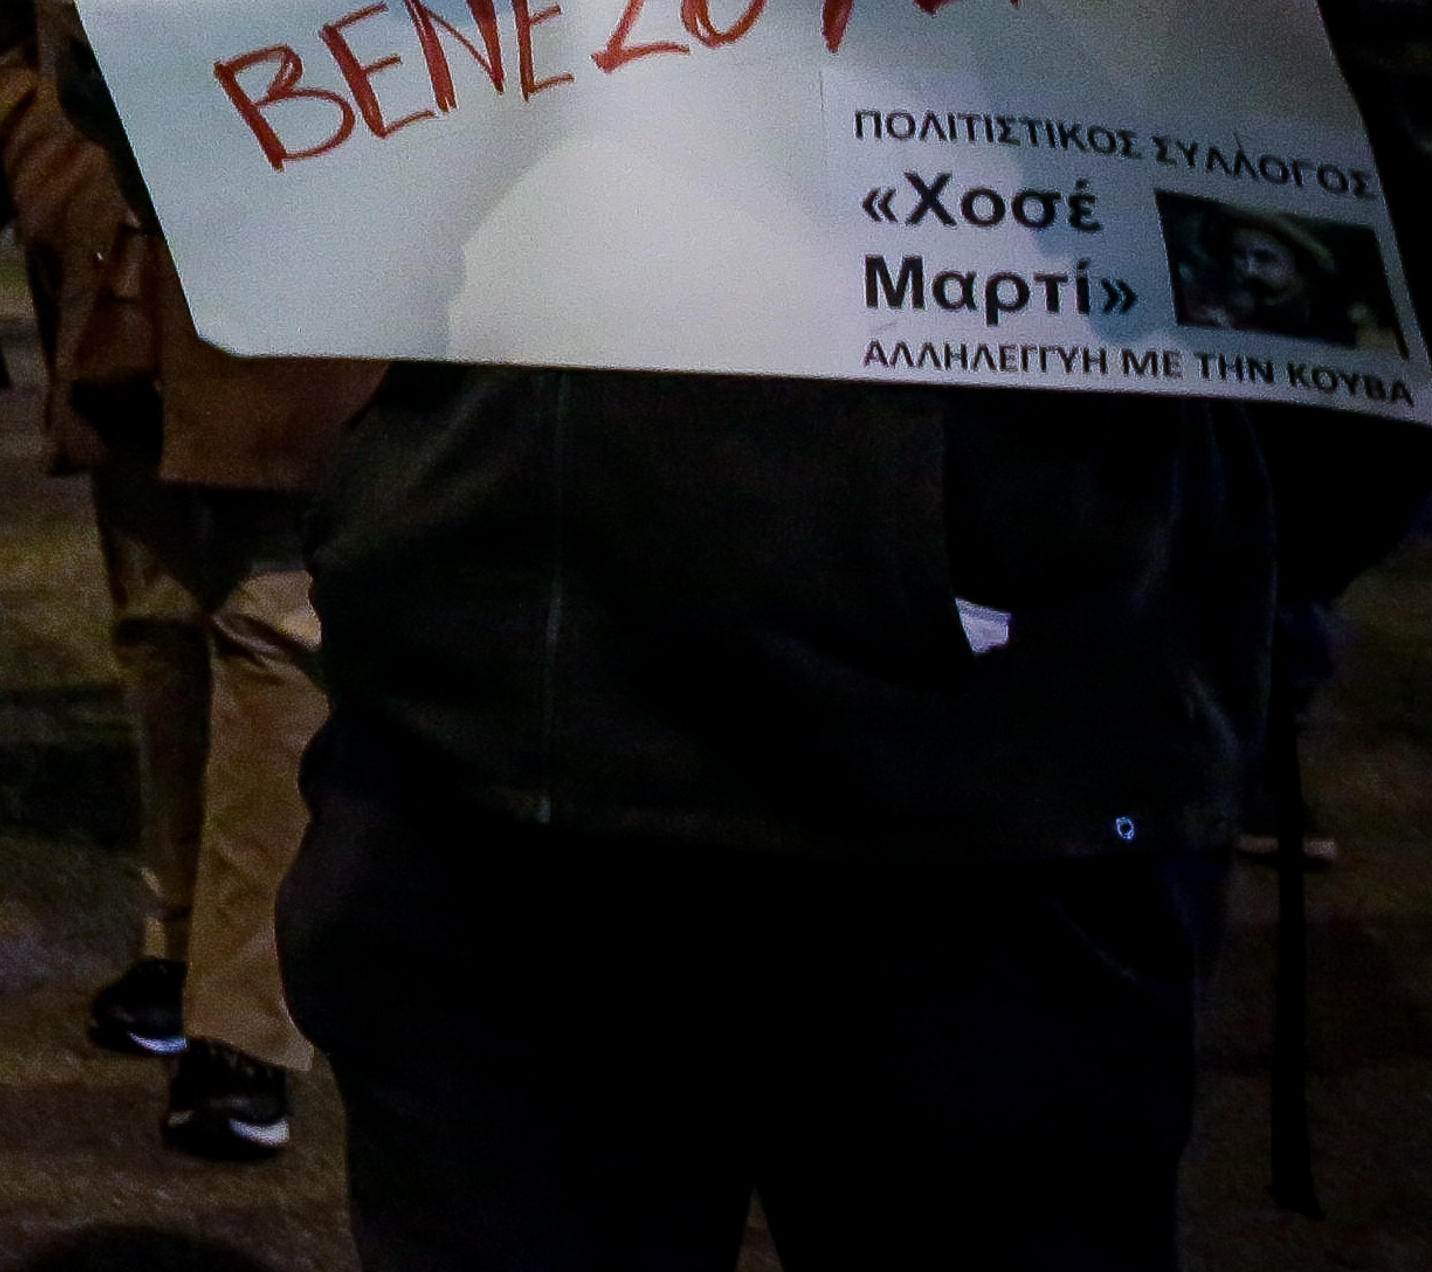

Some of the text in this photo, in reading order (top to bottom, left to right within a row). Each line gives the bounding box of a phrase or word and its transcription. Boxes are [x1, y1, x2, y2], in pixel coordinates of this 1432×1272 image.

[854, 109, 1380, 202] ΠΟΛΙΤΙΣΤΙΚΟΣ ΣΥΛΛΟΓΟΣ
[861, 170, 1104, 233] «Χοσέ
[862, 252, 1139, 326] Μαρτί»
[862, 338, 1417, 410] ΑΛΛΗΛΕΓΓΥΗ ΜΕ ΤΗΝ ΚΟΥΒΑ
